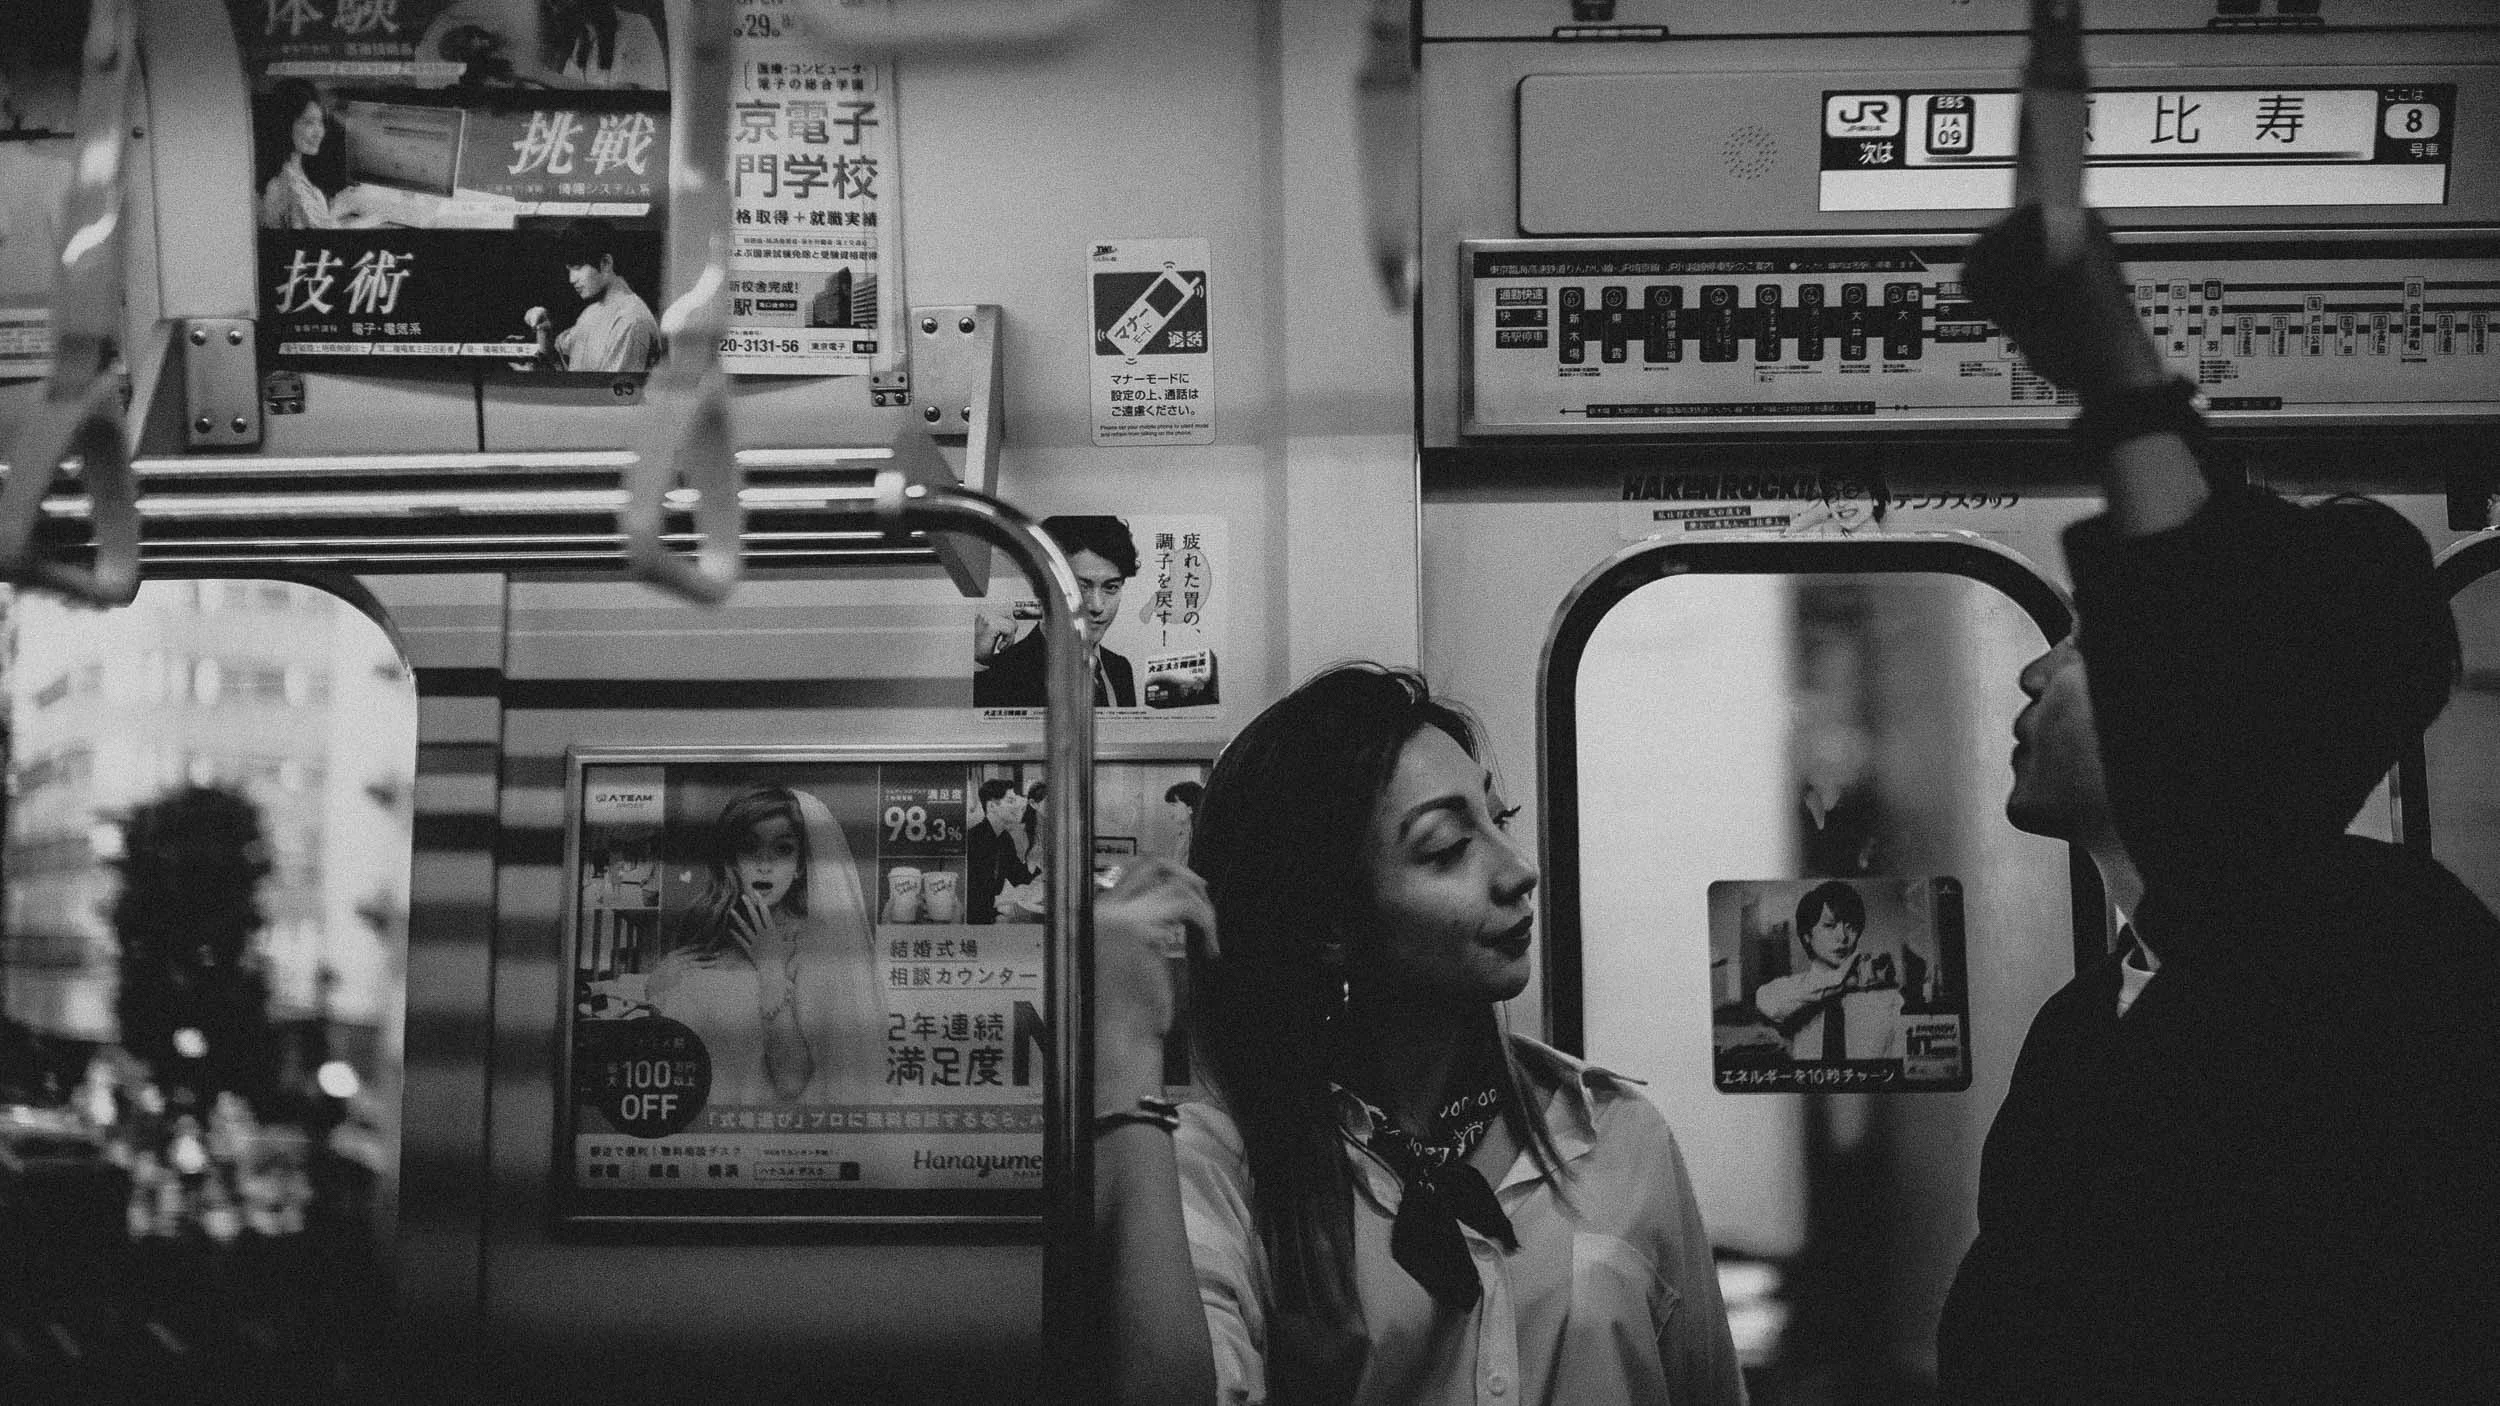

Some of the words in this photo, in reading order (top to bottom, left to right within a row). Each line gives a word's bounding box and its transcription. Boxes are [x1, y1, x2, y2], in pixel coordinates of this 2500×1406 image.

[2383, 89, 2424, 101] ここは
[1838, 100, 1889, 124] JR
[1940, 116, 1961, 128] JA
[2085, 93, 2306, 145] 比寿
[2405, 108, 2424, 133] 8
[508, 110, 656, 176] 挑戦
[1937, 129, 1962, 146] 09
[2408, 142, 2440, 158] 号車
[1859, 141, 1894, 165] 次は
[276, 249, 414, 316] 技術
[1114, 307, 1150, 341] マナー
[1133, 321, 1155, 344] モード
[1851, 310, 1863, 357] 大井町
[1896, 310, 1909, 357] 大崎
[811, 341, 846, 352] 東京電子
[1110, 373, 1190, 386] マナーモードに
[1110, 388, 1200, 402] 設定の上、通話は
[1111, 405, 1196, 417] ご遠慮ください。
[1182, 532, 1202, 635] 疲れた胃の、
[884, 805, 963, 842] 98.3%
[889, 939, 978, 959] 結婚式場
[889, 966, 1038, 986] 相談カウンター
[887, 1011, 1004, 1043] 2年連続
[622, 1059, 672, 1089] 100
[885, 1045, 1004, 1087] 満足度
[620, 1093, 679, 1121] OFF
[912, 1149, 1043, 1178] Hanayume
